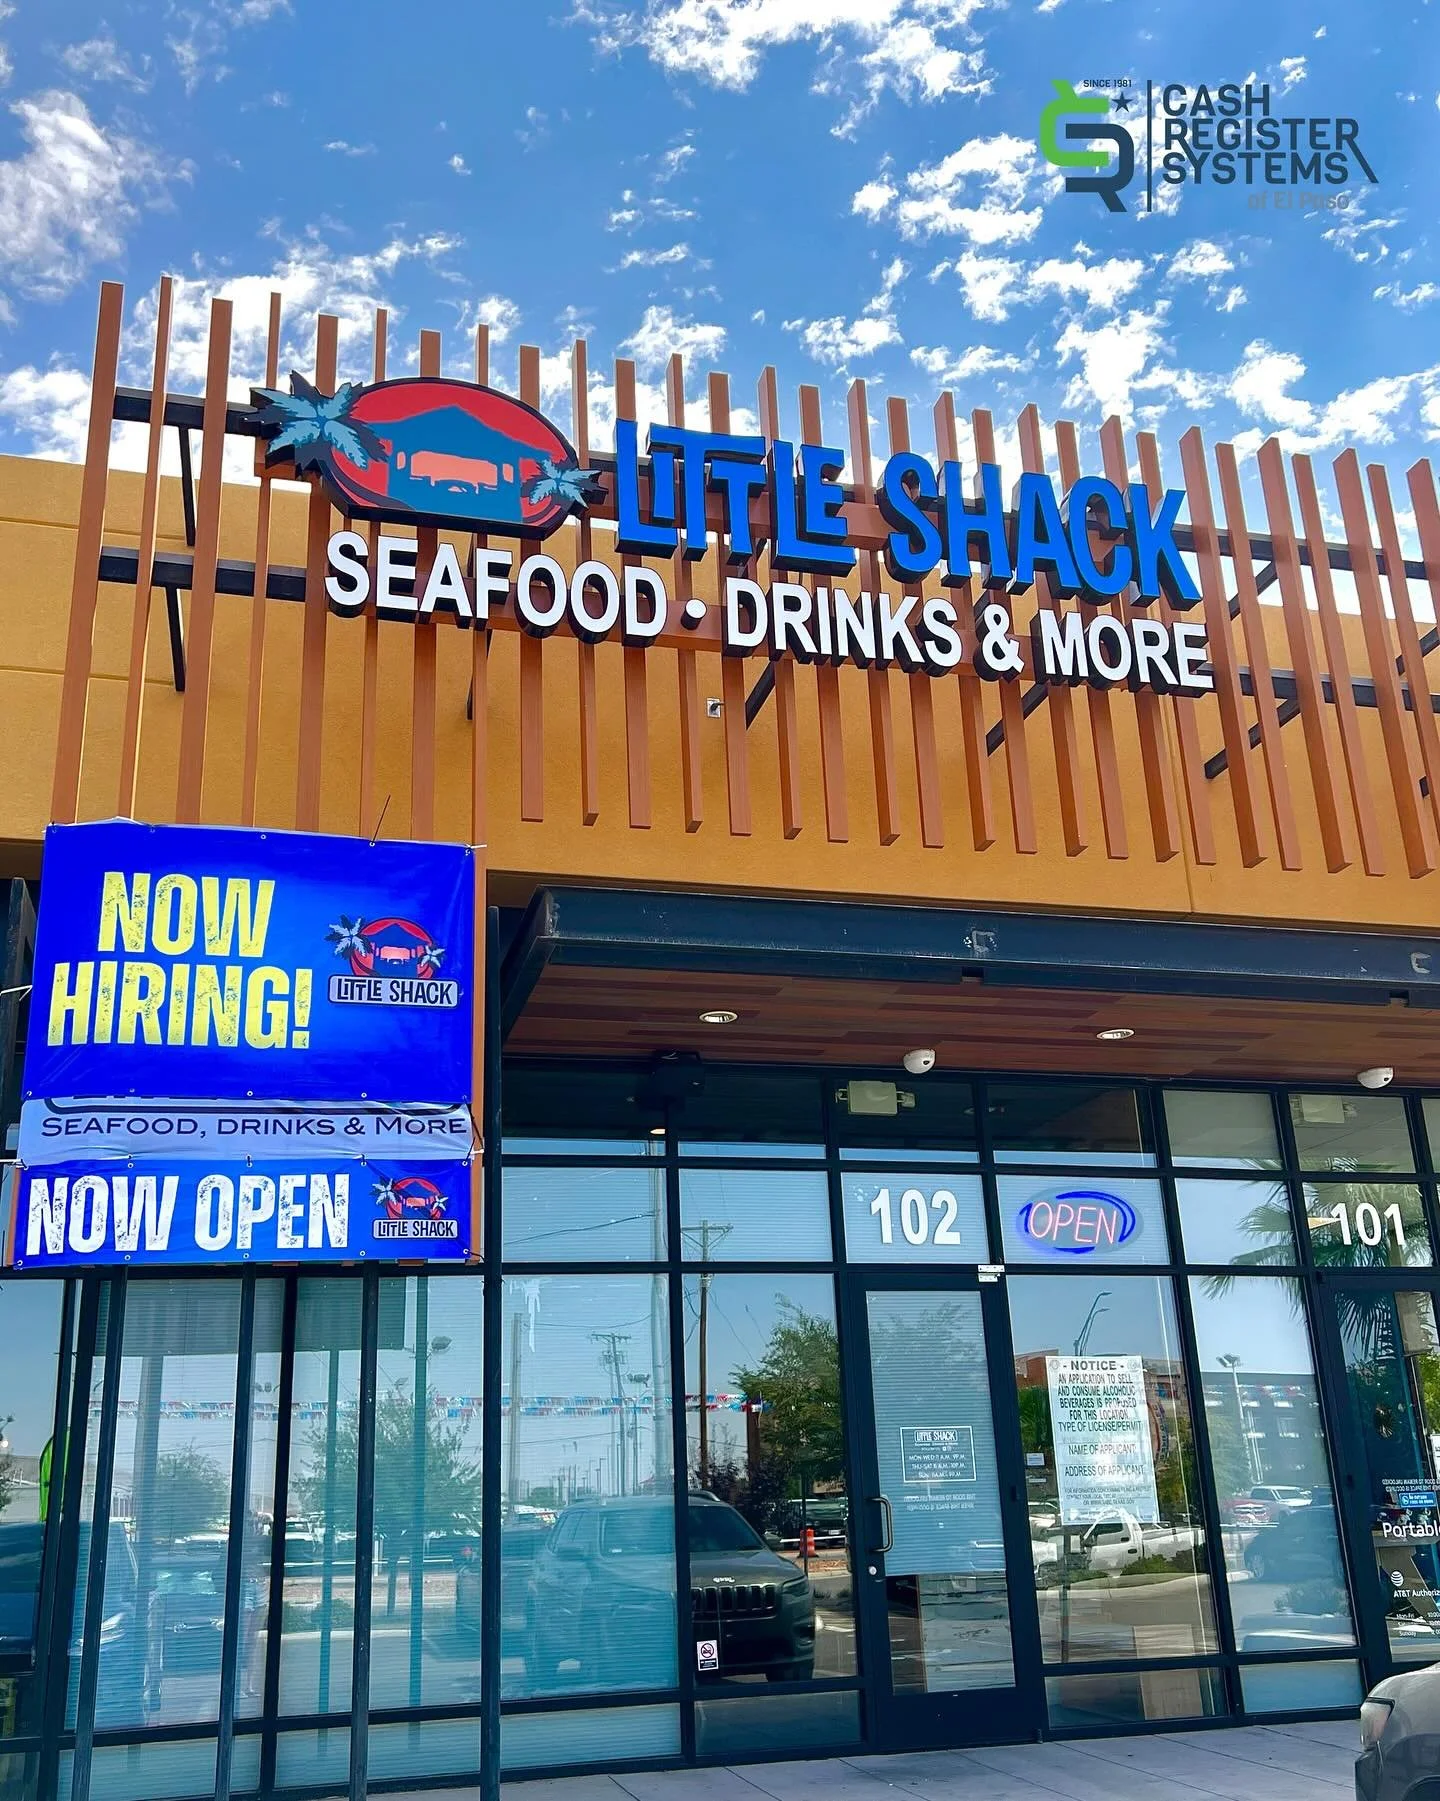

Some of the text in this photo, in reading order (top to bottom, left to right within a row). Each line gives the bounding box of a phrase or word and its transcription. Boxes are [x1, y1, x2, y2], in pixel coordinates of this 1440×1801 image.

[615, 419, 1203, 605] LITTLE SHACK
[325, 531, 1215, 690] SEAFOOD DRINKS & MORE
[98, 871, 276, 957] NOW
[336, 981, 453, 1005] LITTLE SHACK
[47, 961, 313, 1049] HIRING!
[41, 1117, 468, 1139] SEAFOOD, DRINKS & MORE
[25, 1173, 350, 1256] NOW OPEN
[870, 1188, 961, 1245] 102
[1029, 1201, 1118, 1244] OPEN
[377, 1221, 455, 1238] LITTLE SHACK
[1330, 1202, 1406, 1246] 101
[1071, 1361, 1117, 1370] NOTICE
[1058, 1374, 1133, 1384] AN APPLICATION TO SELL
[1058, 1386, 1135, 1396] AND CONSUME ALCOHOLIC
[1060, 1398, 1136, 1408] BEVERAGES IS PROPOSED
[1070, 1410, 1081, 1420] FOR
[1084, 1410, 1097, 1420] THIS
[1058, 1422, 1075, 1432] TYPE
[1077, 1422, 1086, 1432] OF
[916, 1431, 955, 1441] LITTLE SHACK
[1068, 1444, 1136, 1455] NAME OF APPLICANT
[1065, 1464, 1144, 1476] ADDRESS OF APPLICANT
[1382, 1520, 1440, 1538] Portabl
[1393, 1590, 1410, 1598] AT&T
